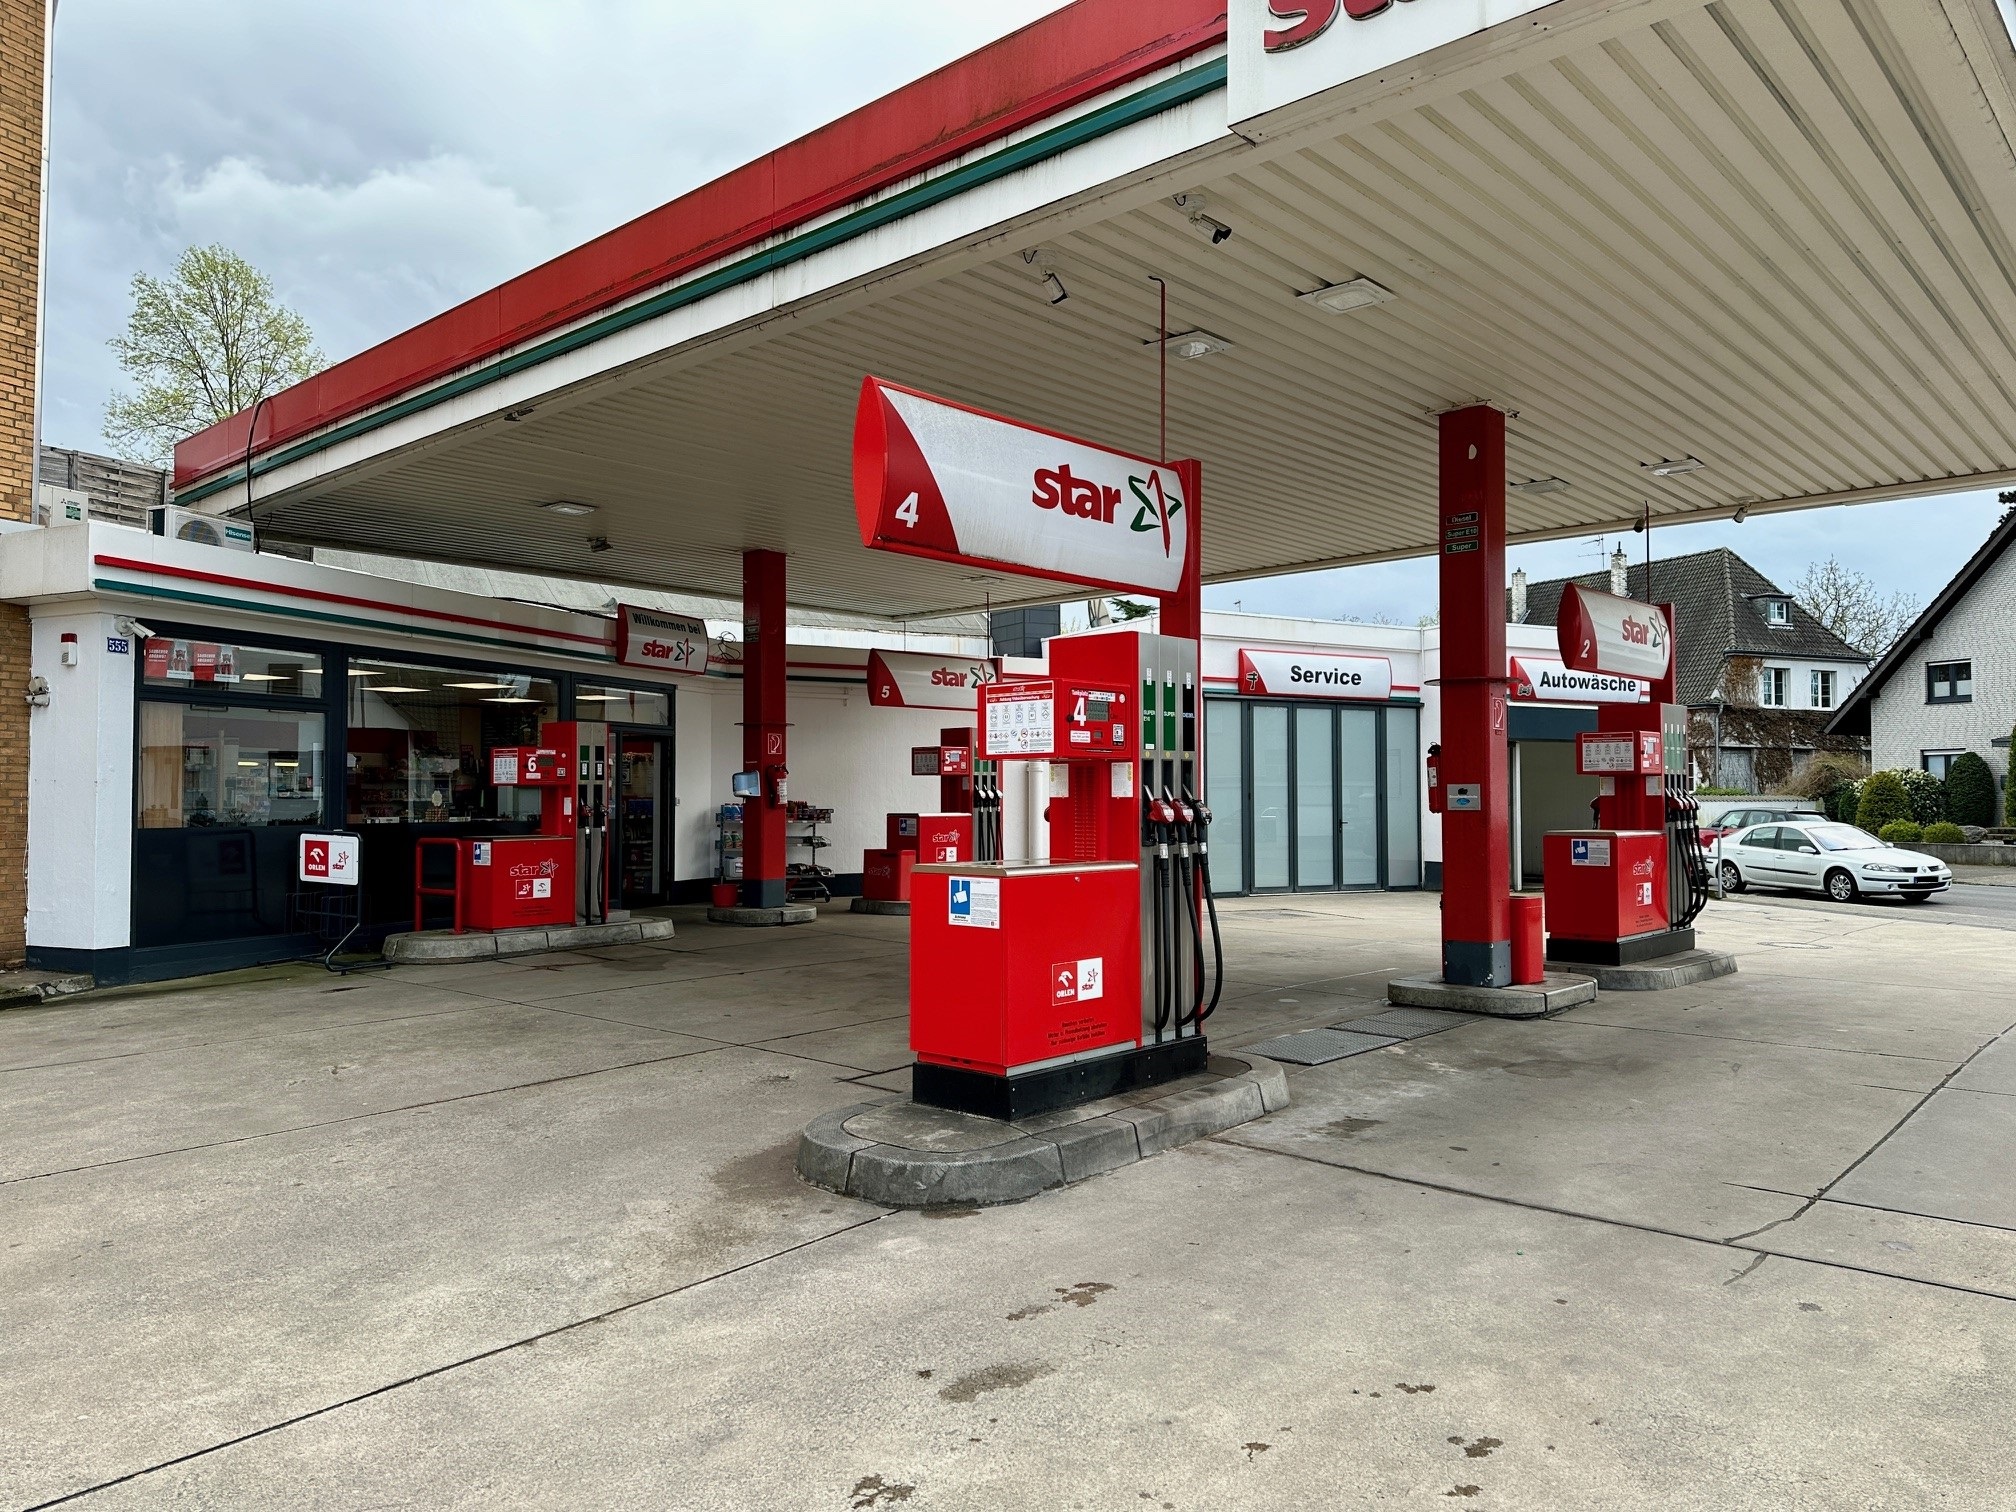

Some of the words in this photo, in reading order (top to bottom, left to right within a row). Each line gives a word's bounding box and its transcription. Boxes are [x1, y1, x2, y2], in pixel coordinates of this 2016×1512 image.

[1032, 464, 1122, 524] star
[895, 491, 919, 528] 4
[225, 529, 251, 539] Hisense
[1451, 543, 1472, 551] Super
[632, 613, 687, 632] Willkommen
[688, 623, 701, 634] bei
[1622, 614, 1649, 646] star
[109, 640, 127, 652] 555
[641, 639, 673, 659] star
[1580, 639, 1591, 658] 2
[930, 667, 967, 687] star
[1290, 665, 1362, 686] Service
[1539, 671, 1636, 692] Autowäsche
[881, 685, 890, 698] 5
[1073, 697, 1087, 727] 4
[527, 757, 537, 772] 6
[944, 752, 952, 764] 5
[510, 863, 539, 876] star
[1056, 988, 1075, 998] ORLEN
[1081, 983, 1094, 991] star
